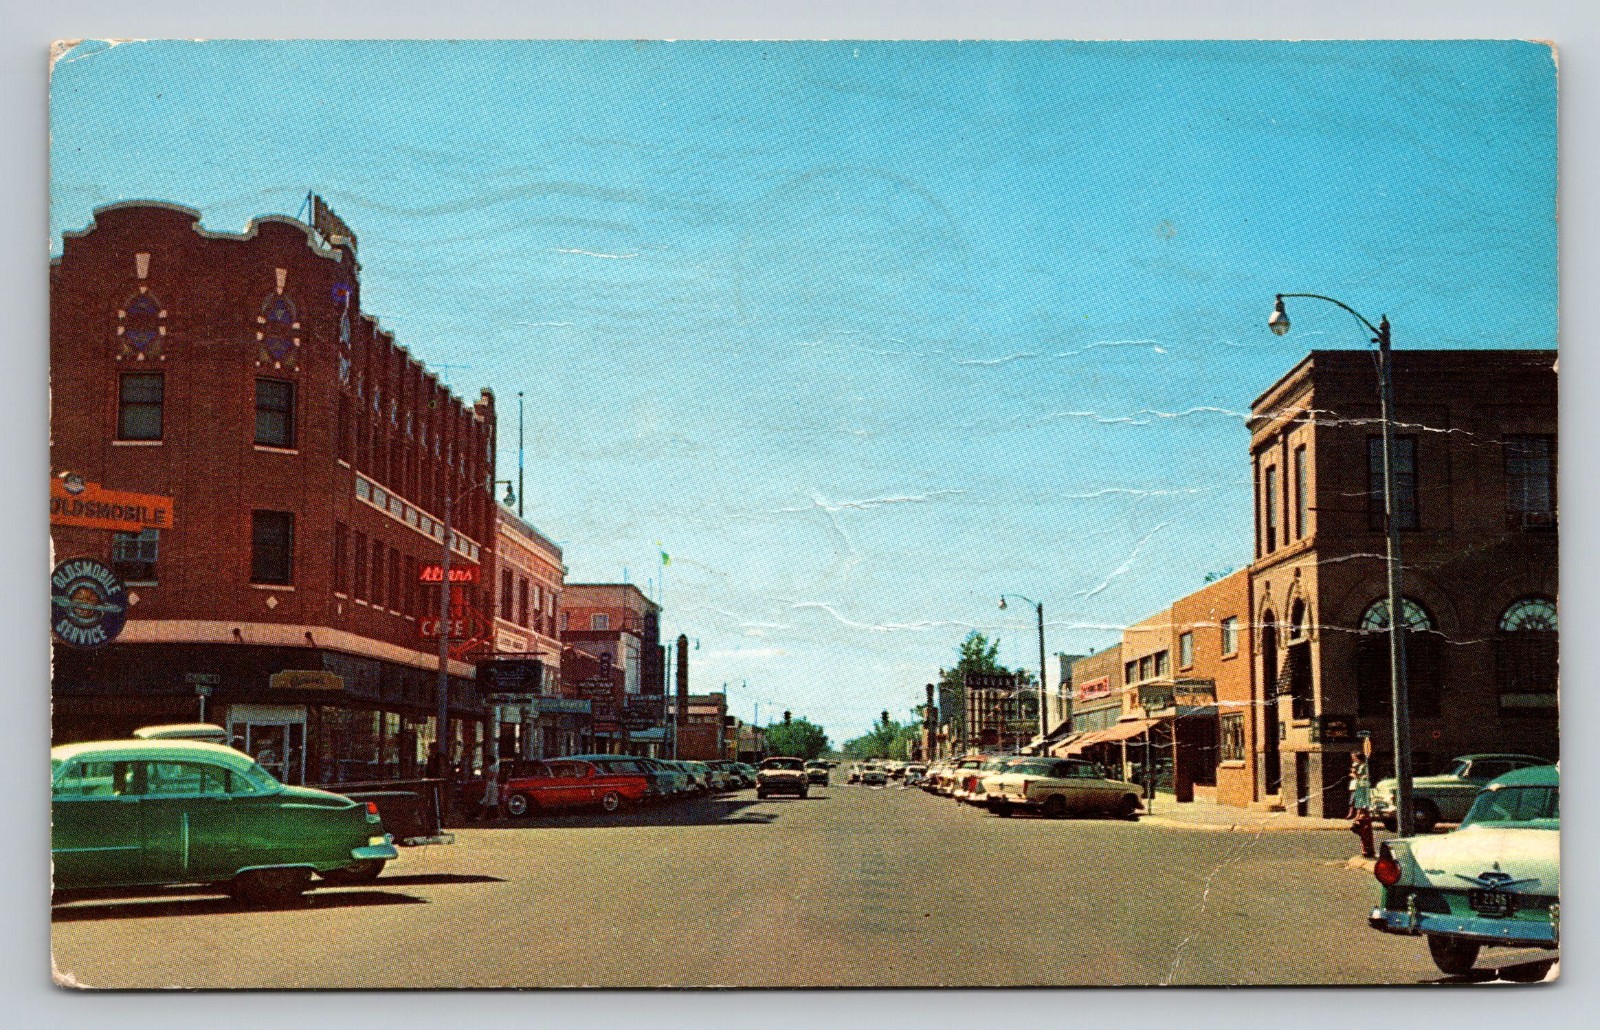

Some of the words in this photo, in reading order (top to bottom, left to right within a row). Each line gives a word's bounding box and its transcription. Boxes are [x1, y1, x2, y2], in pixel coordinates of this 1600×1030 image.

[51, 498, 166, 524] OLDSMOBILE
[53, 561, 122, 596] OLDSMOBILE
[55, 619, 108, 645] SERVICE
